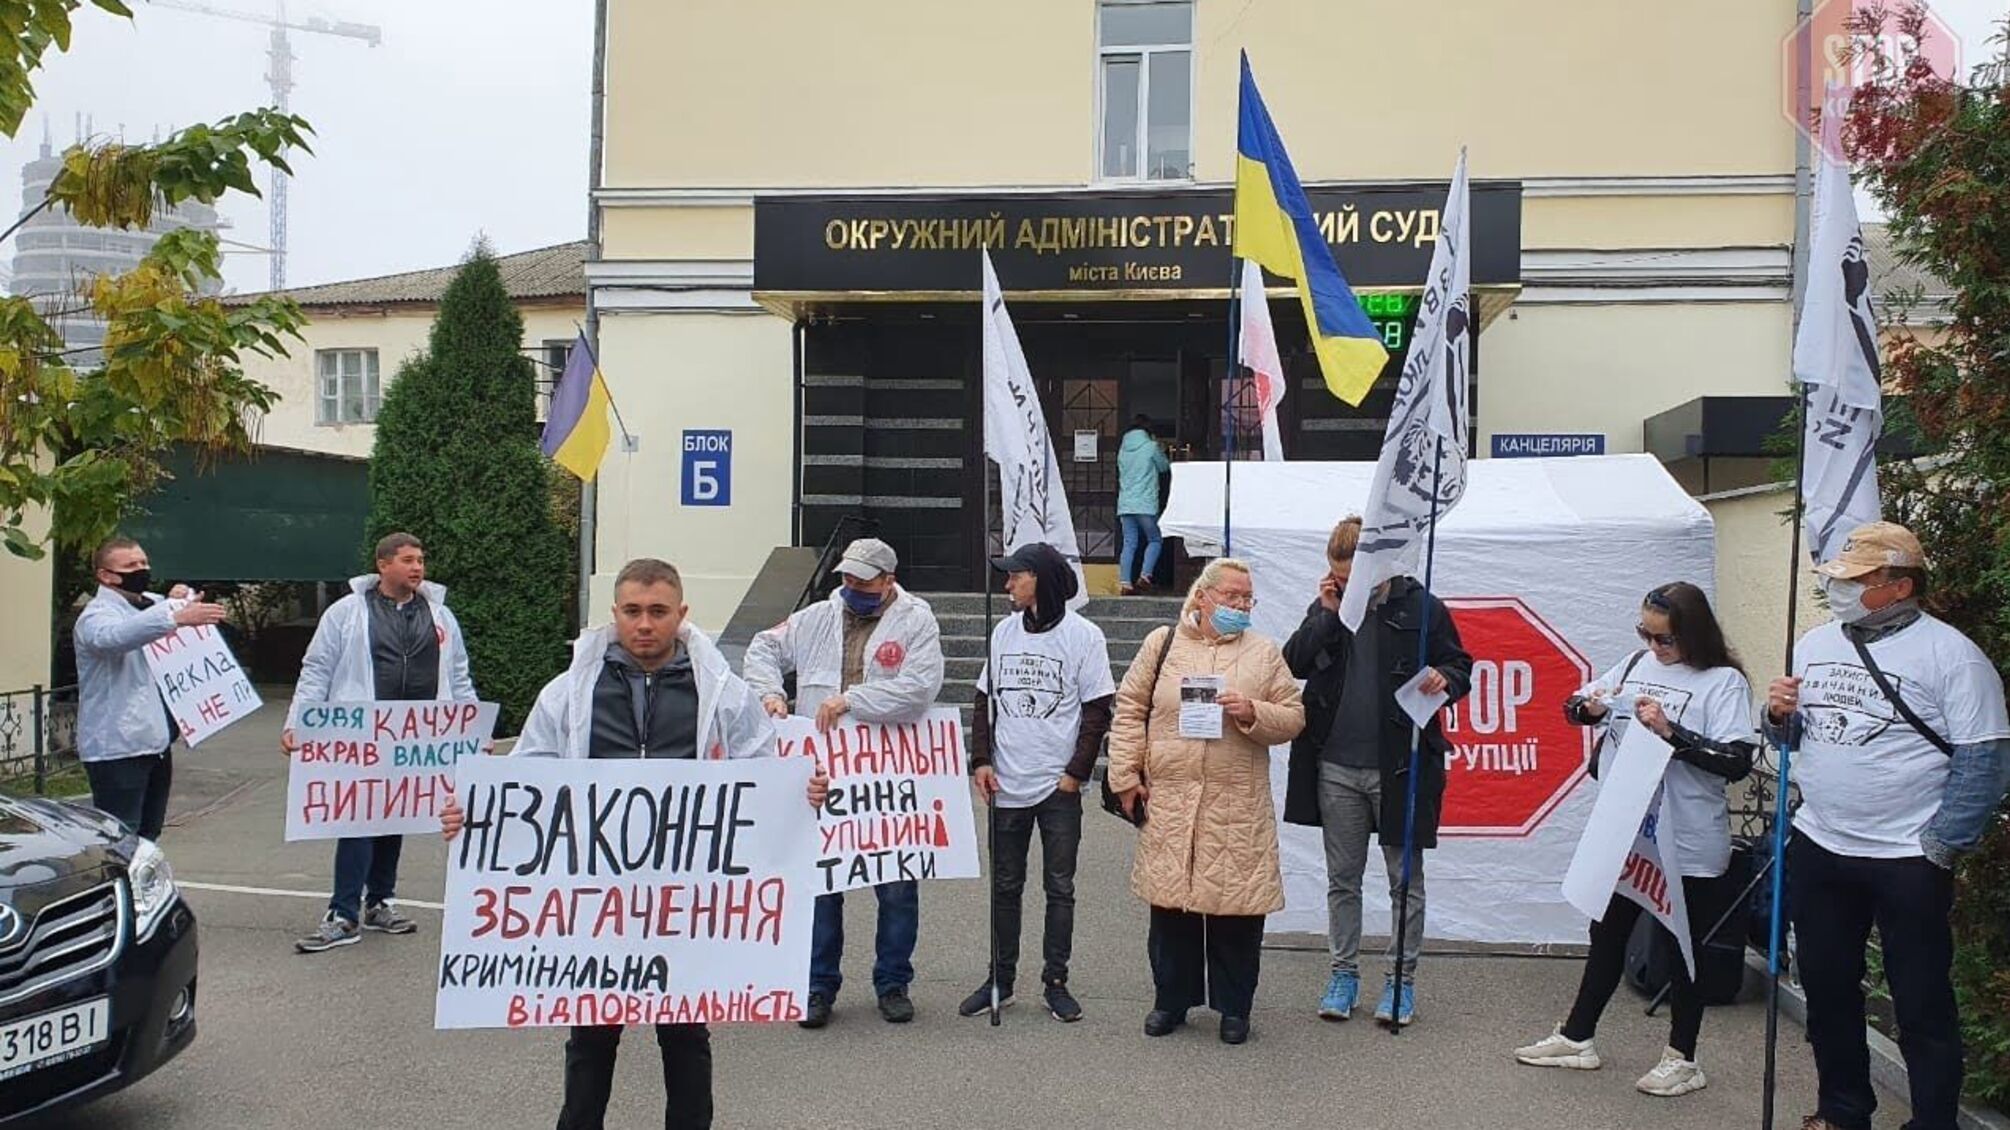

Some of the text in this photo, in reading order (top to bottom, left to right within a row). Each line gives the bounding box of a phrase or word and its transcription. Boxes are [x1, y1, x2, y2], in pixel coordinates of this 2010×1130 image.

[825, 204, 1439, 253] ОКРУЖНИЙ АДМІНІСТРАТИЙ СУД
[1068, 259, 1182, 283] міста Києва
[683, 435, 729, 452] БЛОК
[1500, 438, 1596, 454] КАНЦЕЛЯРІЯ
[693, 460, 719, 500] Б
[302, 704, 478, 741] СУДЯ КАЧУР
[301, 740, 380, 767] ВКРАВ
[1444, 738, 1539, 775] РУПЦІЇ
[460, 782, 757, 877] НЕЗАКОННЕ
[817, 850, 936, 891] ТАТКИ
[471, 878, 784, 945] ЗБАГАЧЕННЯ
